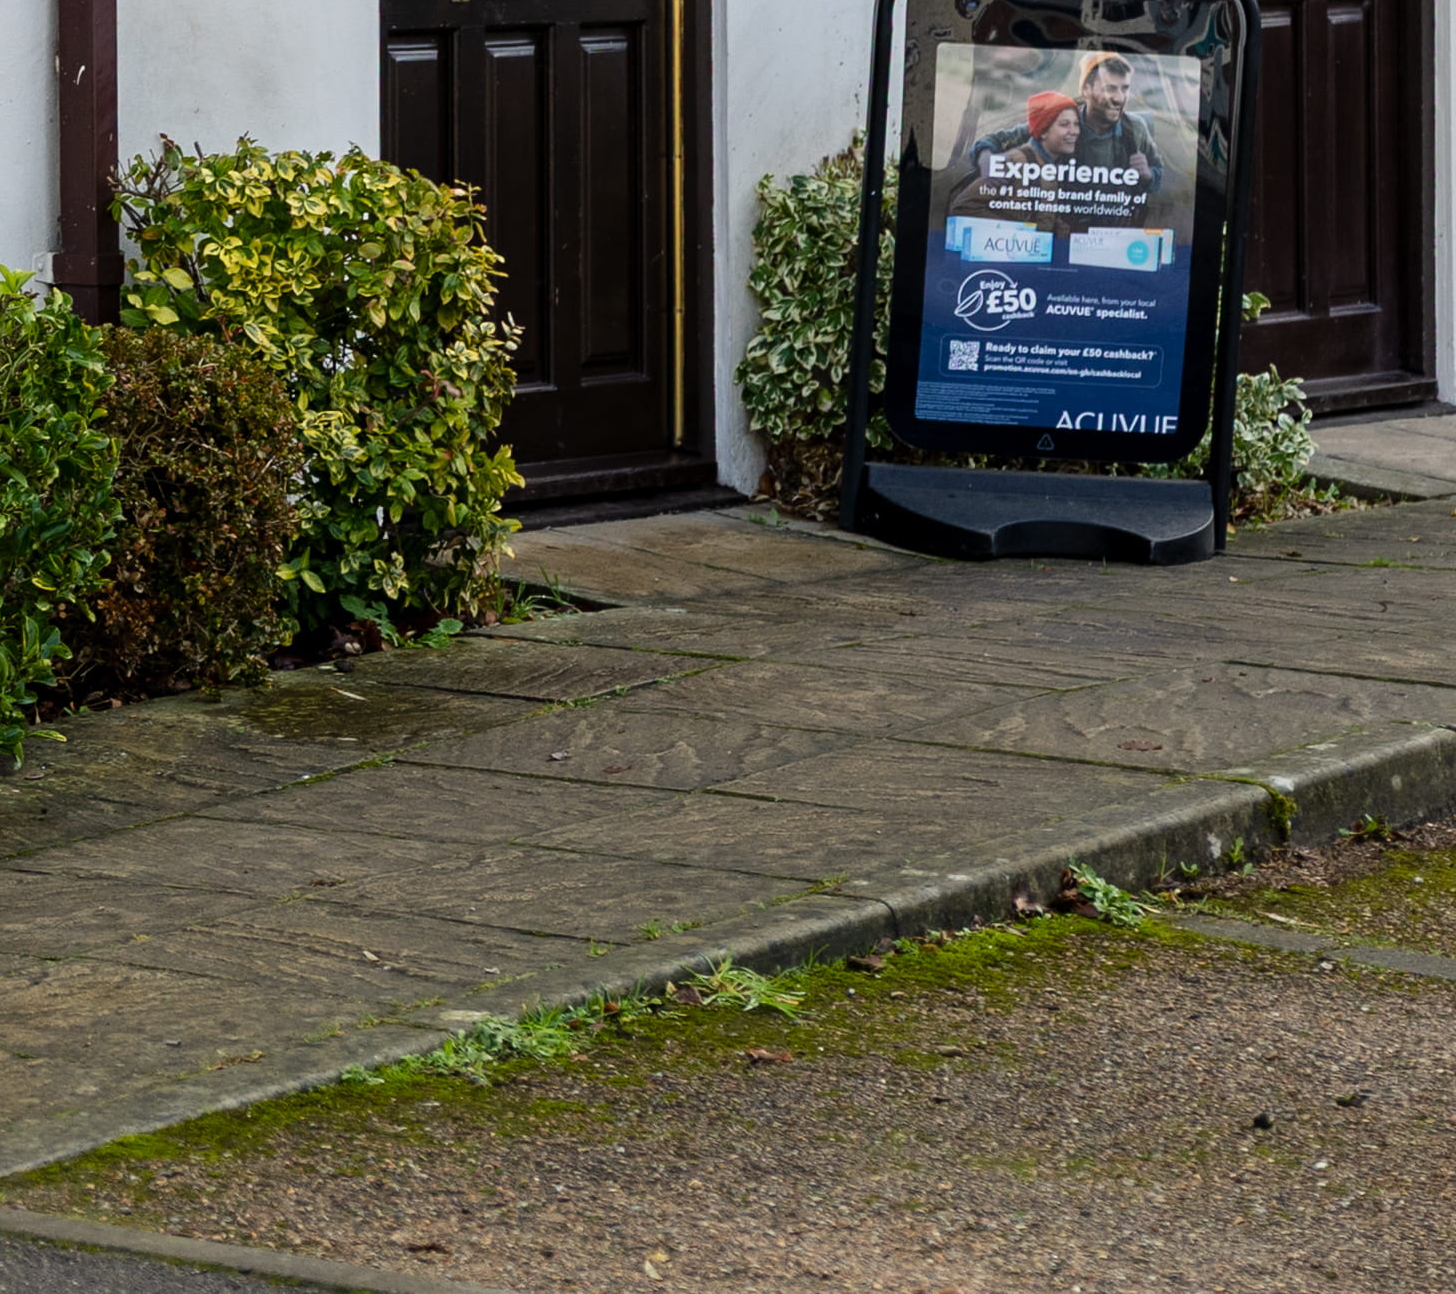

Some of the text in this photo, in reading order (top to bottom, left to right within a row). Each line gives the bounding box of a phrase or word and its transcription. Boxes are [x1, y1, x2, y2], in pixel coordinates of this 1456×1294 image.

[988, 154, 1140, 186] Experience
[979, 185, 1148, 206] the #1 selling brand family of
[989, 199, 1032, 211] contact
[1034, 200, 1071, 213] lenses
[984, 237, 1040, 253] ACUVUE
[979, 280, 1006, 290] Enjoy
[986, 288, 1037, 314] £50
[1046, 293, 1080, 303] Available
[1101, 296, 1119, 306] from
[1120, 299, 1137, 307] your
[1137, 298, 1156, 307] local
[1096, 307, 1148, 320] specialist.
[985, 342, 1017, 355] Ready
[1018, 343, 1029, 353] to
[1030, 344, 1057, 355] claim
[1058, 347, 1080, 357] your
[1082, 347, 1102, 358] £50
[985, 354, 1001, 362] Scan
[1002, 355, 1013, 363] the
[1014, 355, 1026, 363] QR
[1027, 356, 1044, 364] code
[1054, 357, 1068, 366] visit
